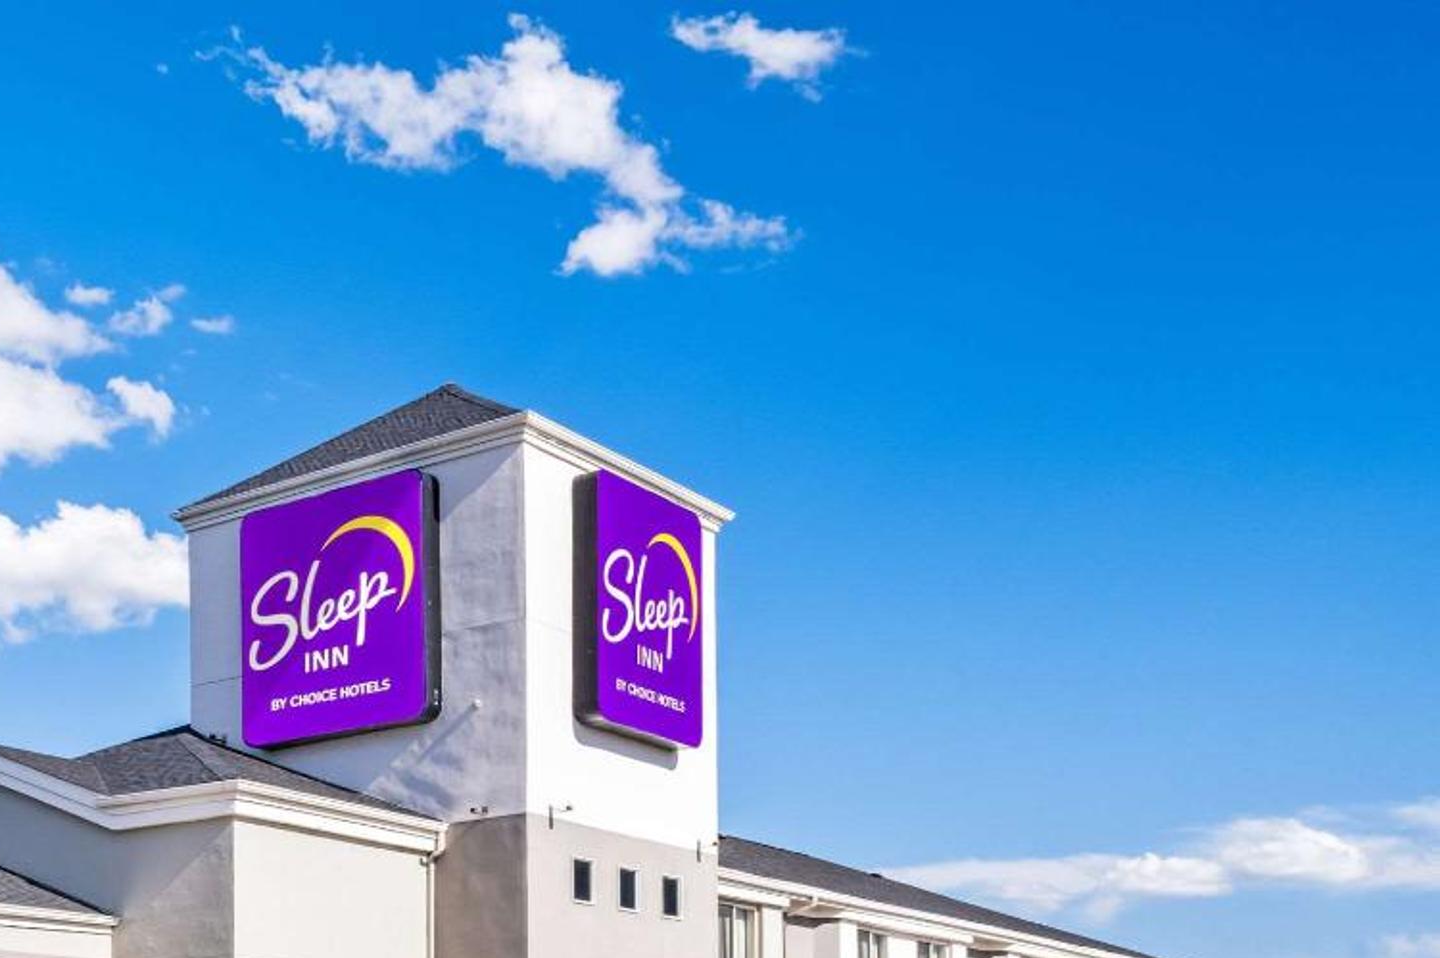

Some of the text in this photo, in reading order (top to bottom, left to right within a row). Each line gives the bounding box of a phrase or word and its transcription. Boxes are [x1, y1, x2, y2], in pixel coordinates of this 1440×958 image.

[249, 559, 397, 671] Sleep
[602, 548, 689, 660] Sleep
[304, 644, 349, 674] INN
[636, 643, 663, 673] INN
[270, 677, 392, 711] BY CHOICE HOTELS
[615, 677, 686, 713] BY CHOICE HOTELS
